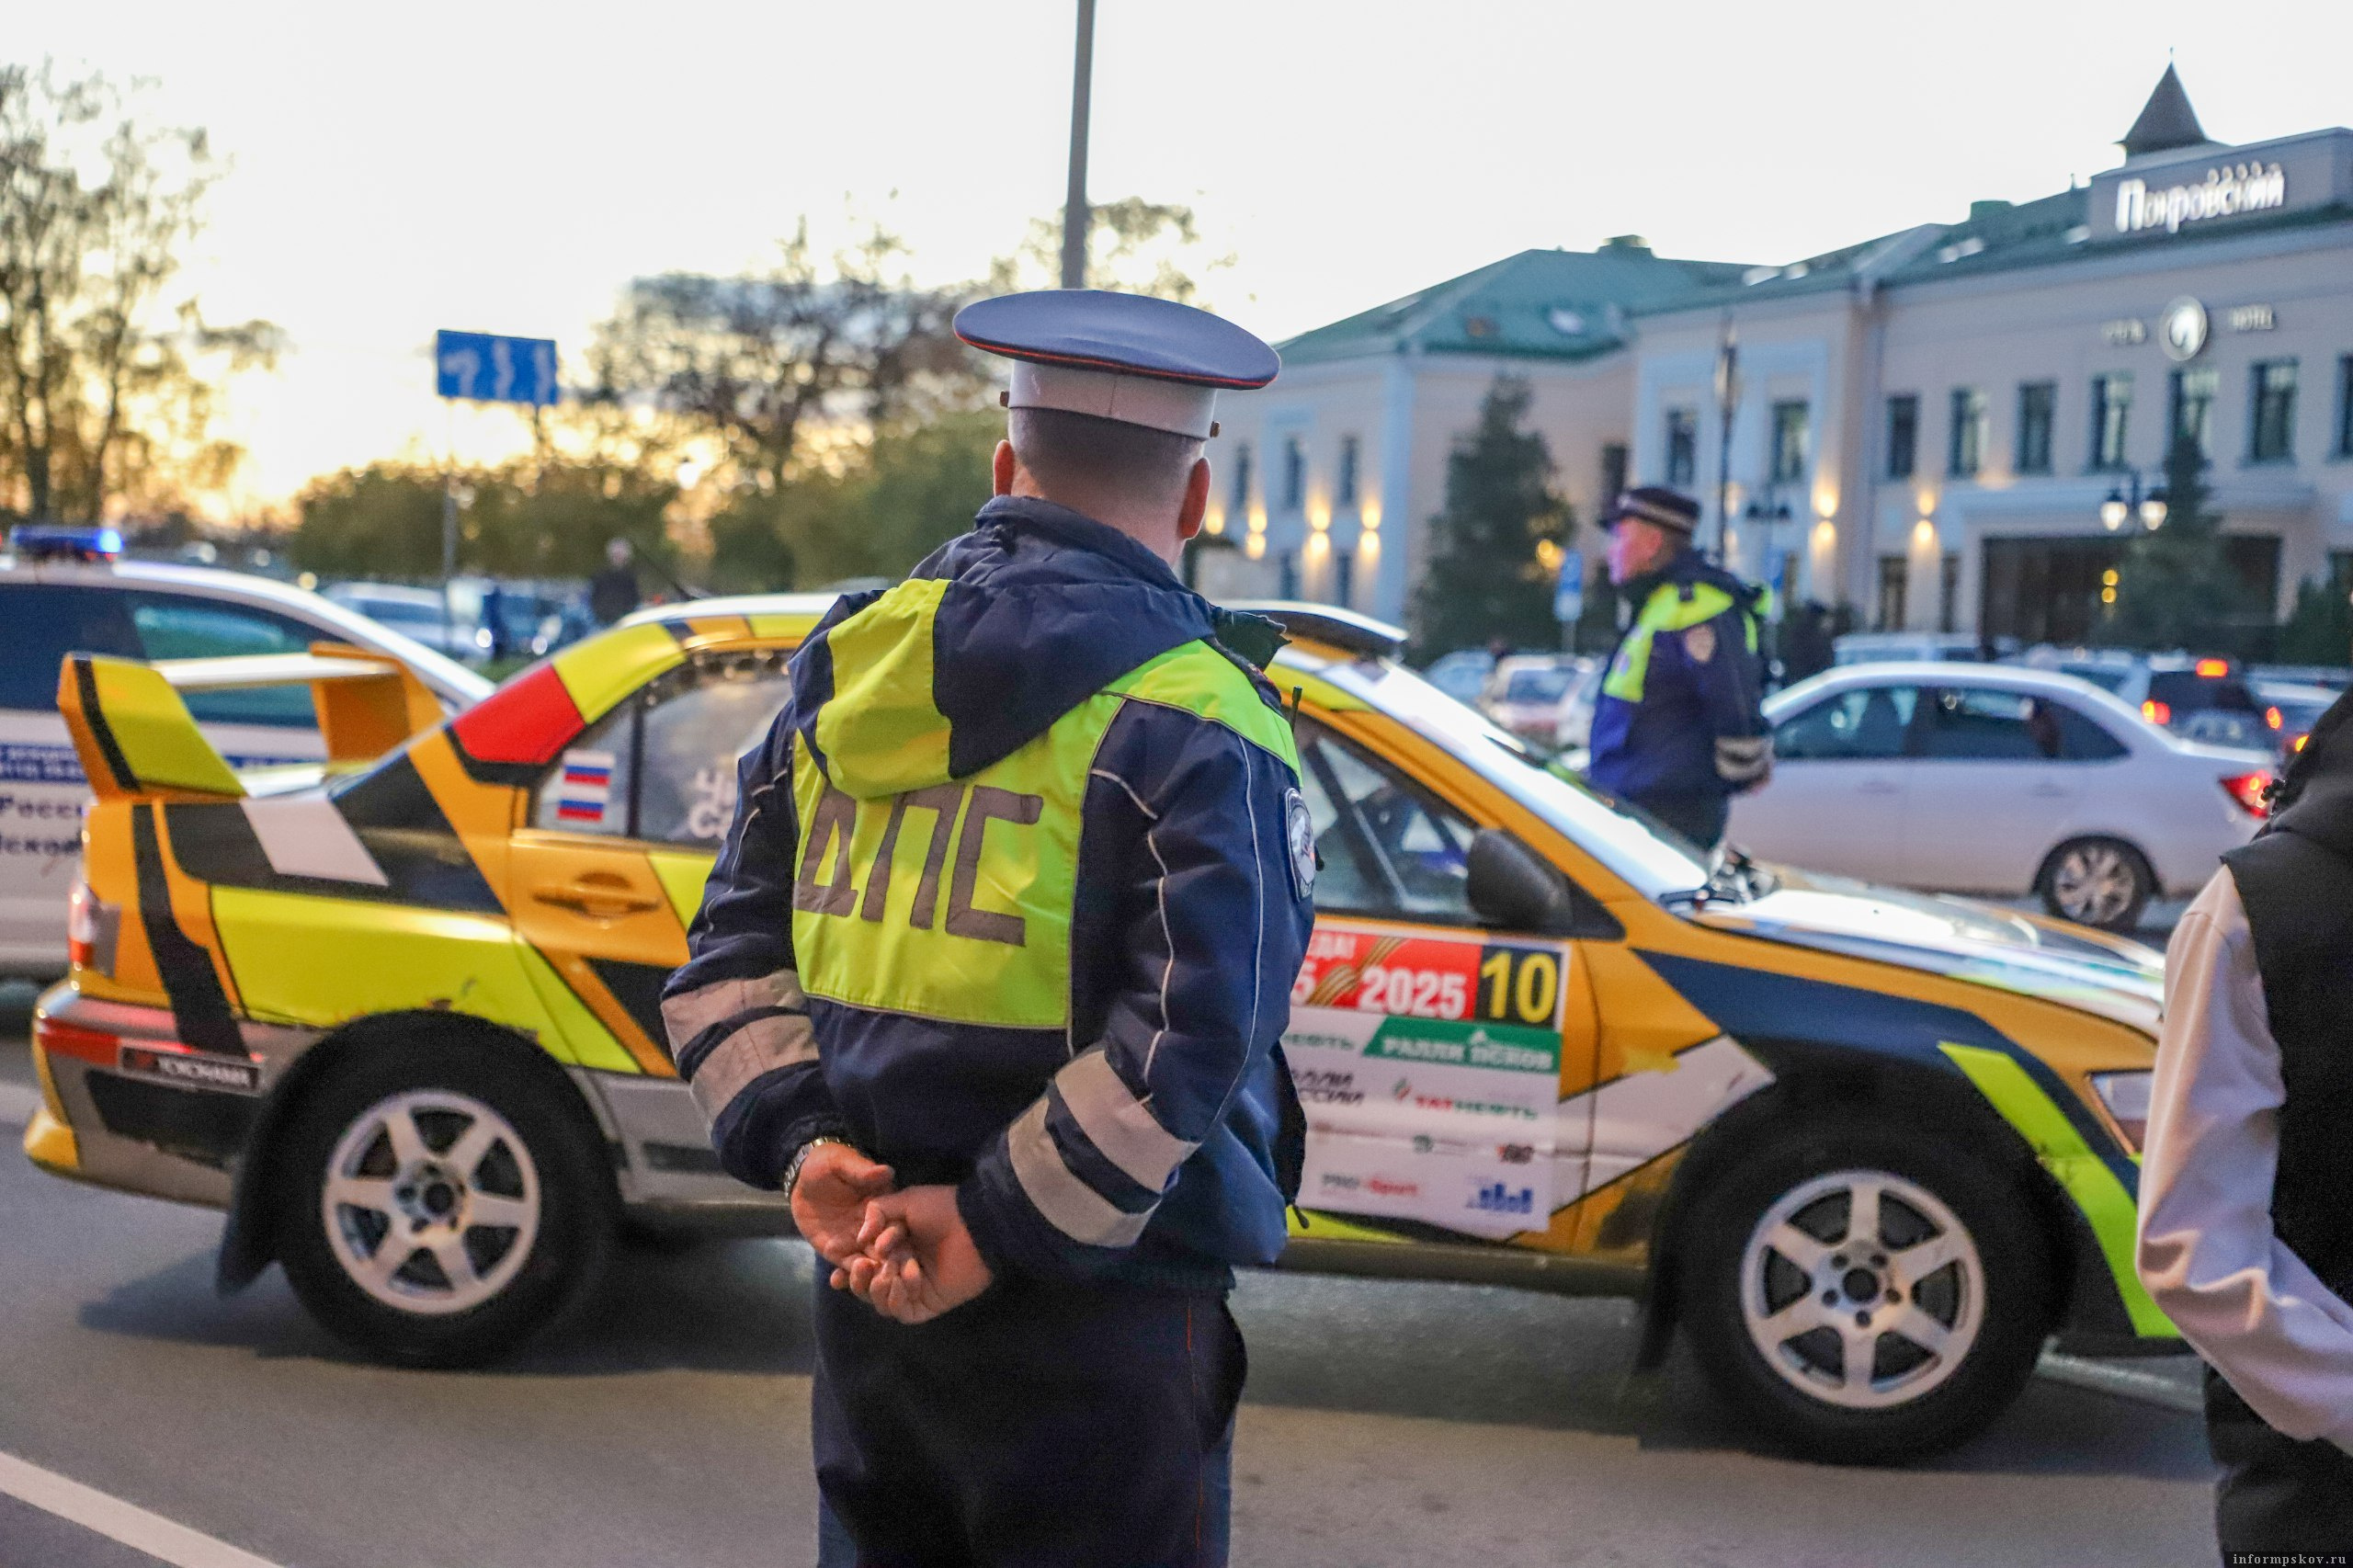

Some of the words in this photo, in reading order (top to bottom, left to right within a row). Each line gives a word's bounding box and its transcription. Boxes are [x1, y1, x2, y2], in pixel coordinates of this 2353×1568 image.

[793, 783, 1044, 948] ДПС
[1290, 960, 1316, 1006] 5
[1358, 965, 1467, 1020] 2025
[1481, 950, 1558, 1023] 10
